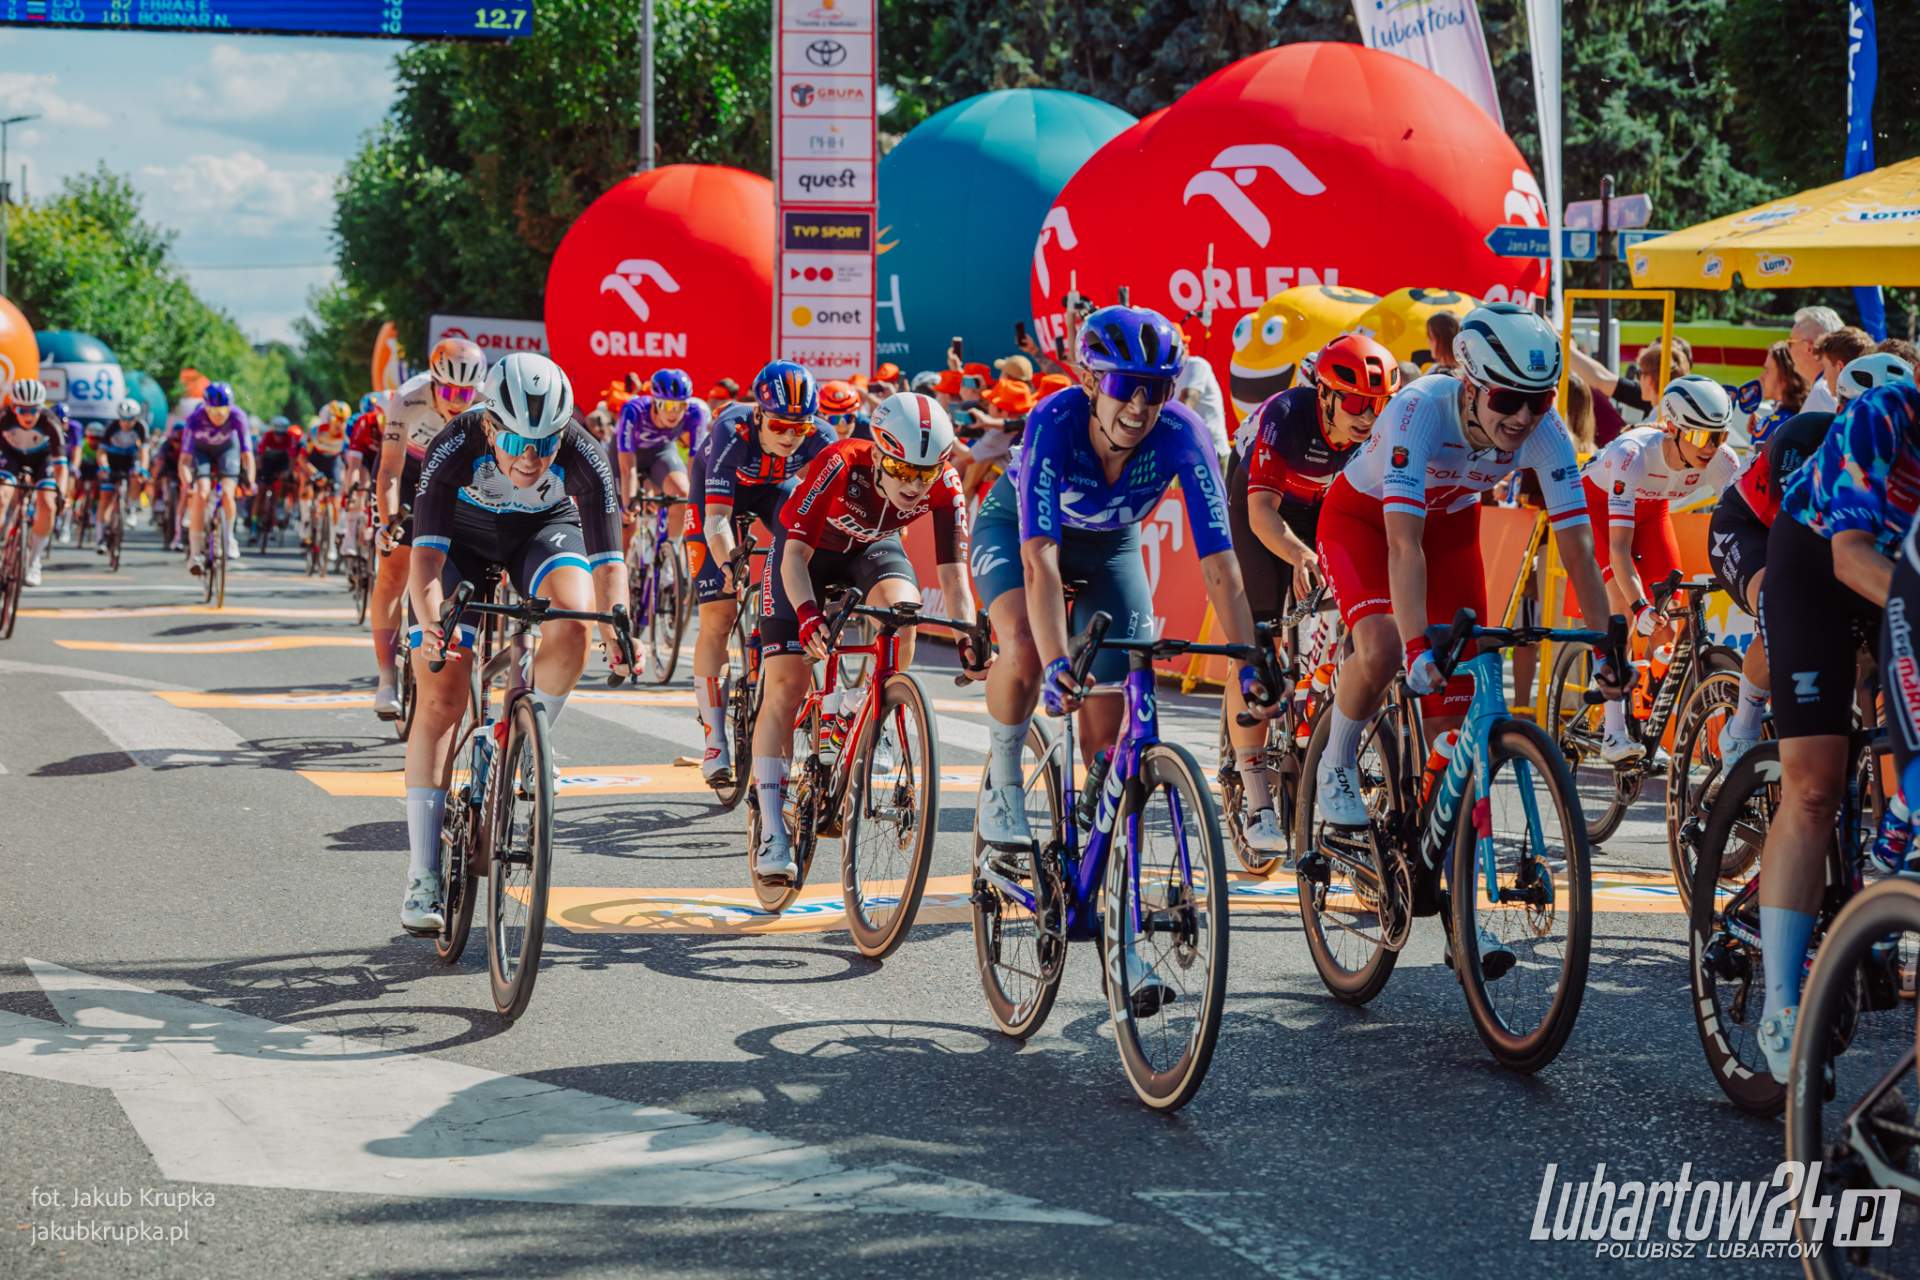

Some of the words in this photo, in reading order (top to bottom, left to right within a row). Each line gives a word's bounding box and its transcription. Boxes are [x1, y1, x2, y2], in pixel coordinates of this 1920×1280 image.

[51, 9, 84, 22] SLO
[102, 11, 130, 23] 161
[138, 12, 210, 25] BOBNAR
[214, 14, 231, 27] N.
[474, 8, 527, 30] 12.7
[817, 88, 864, 98] GRUPA
[798, 168, 856, 193] quest
[793, 225, 818, 237] TVP
[821, 226, 862, 239] SPORT
[1507, 238, 1528, 252] Jana
[817, 309, 862, 324] onet
[475, 334, 541, 351] ORLEN
[590, 330, 687, 357] ORLEN
[70, 370, 113, 400] est
[1548, 410, 1568, 440] OLSKA
[415, 430, 467, 498] VolkerWess
[574, 437, 616, 514] VolkerWessels
[1426, 466, 1497, 484] POLSK
[706, 478, 731, 488] aisin
[1031, 457, 1056, 531] Jayco
[1635, 486, 1690, 498] POLSK
[1193, 464, 1228, 536] Jayco
[1645, 639, 1693, 738] CANYON
[1700, 681, 1733, 709] INC
[1669, 710, 1700, 822] BLACK
[1864, 745, 1875, 784] CTOR
[1095, 766, 1125, 834] Liv
[1331, 856, 1357, 878] OSTRO
